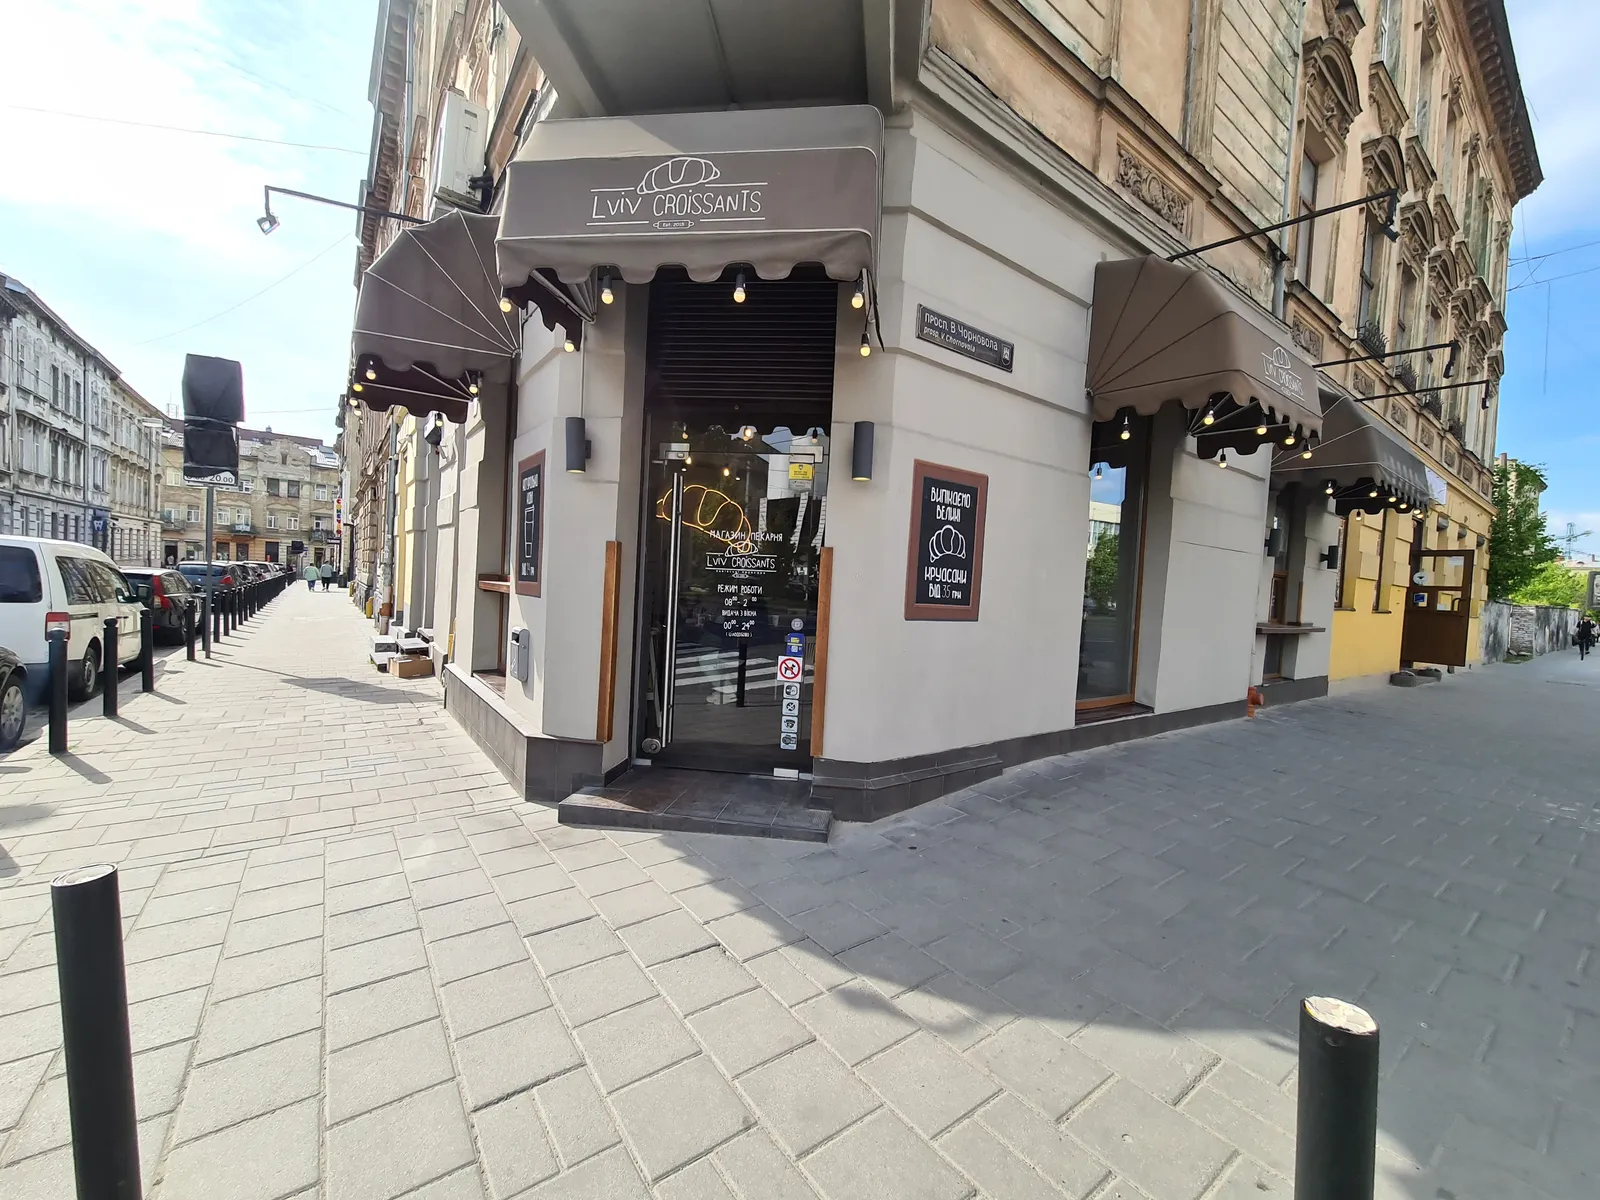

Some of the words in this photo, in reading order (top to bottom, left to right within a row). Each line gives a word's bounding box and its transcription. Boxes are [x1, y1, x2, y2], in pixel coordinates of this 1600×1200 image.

[945, 334, 976, 353] Chornovola
[957, 324, 998, 351] Чорновола
[930, 486, 971, 509] ВИПІКАЄМО
[936, 504, 961, 523] ВЕЛИКІ
[709, 529, 746, 540] МАГАЗИН
[750, 531, 783, 542] ПЕКАРНЯ
[924, 566, 968, 584] КРУАСАНИ
[717, 584, 738, 593] РЕЖИМ
[740, 585, 763, 594] РОБОТИ
[928, 583, 941, 599] ВІД
[941, 584, 951, 599] 35
[721, 609, 740, 617] ВИДАЧА
[744, 608, 757, 617] ВІКНА
